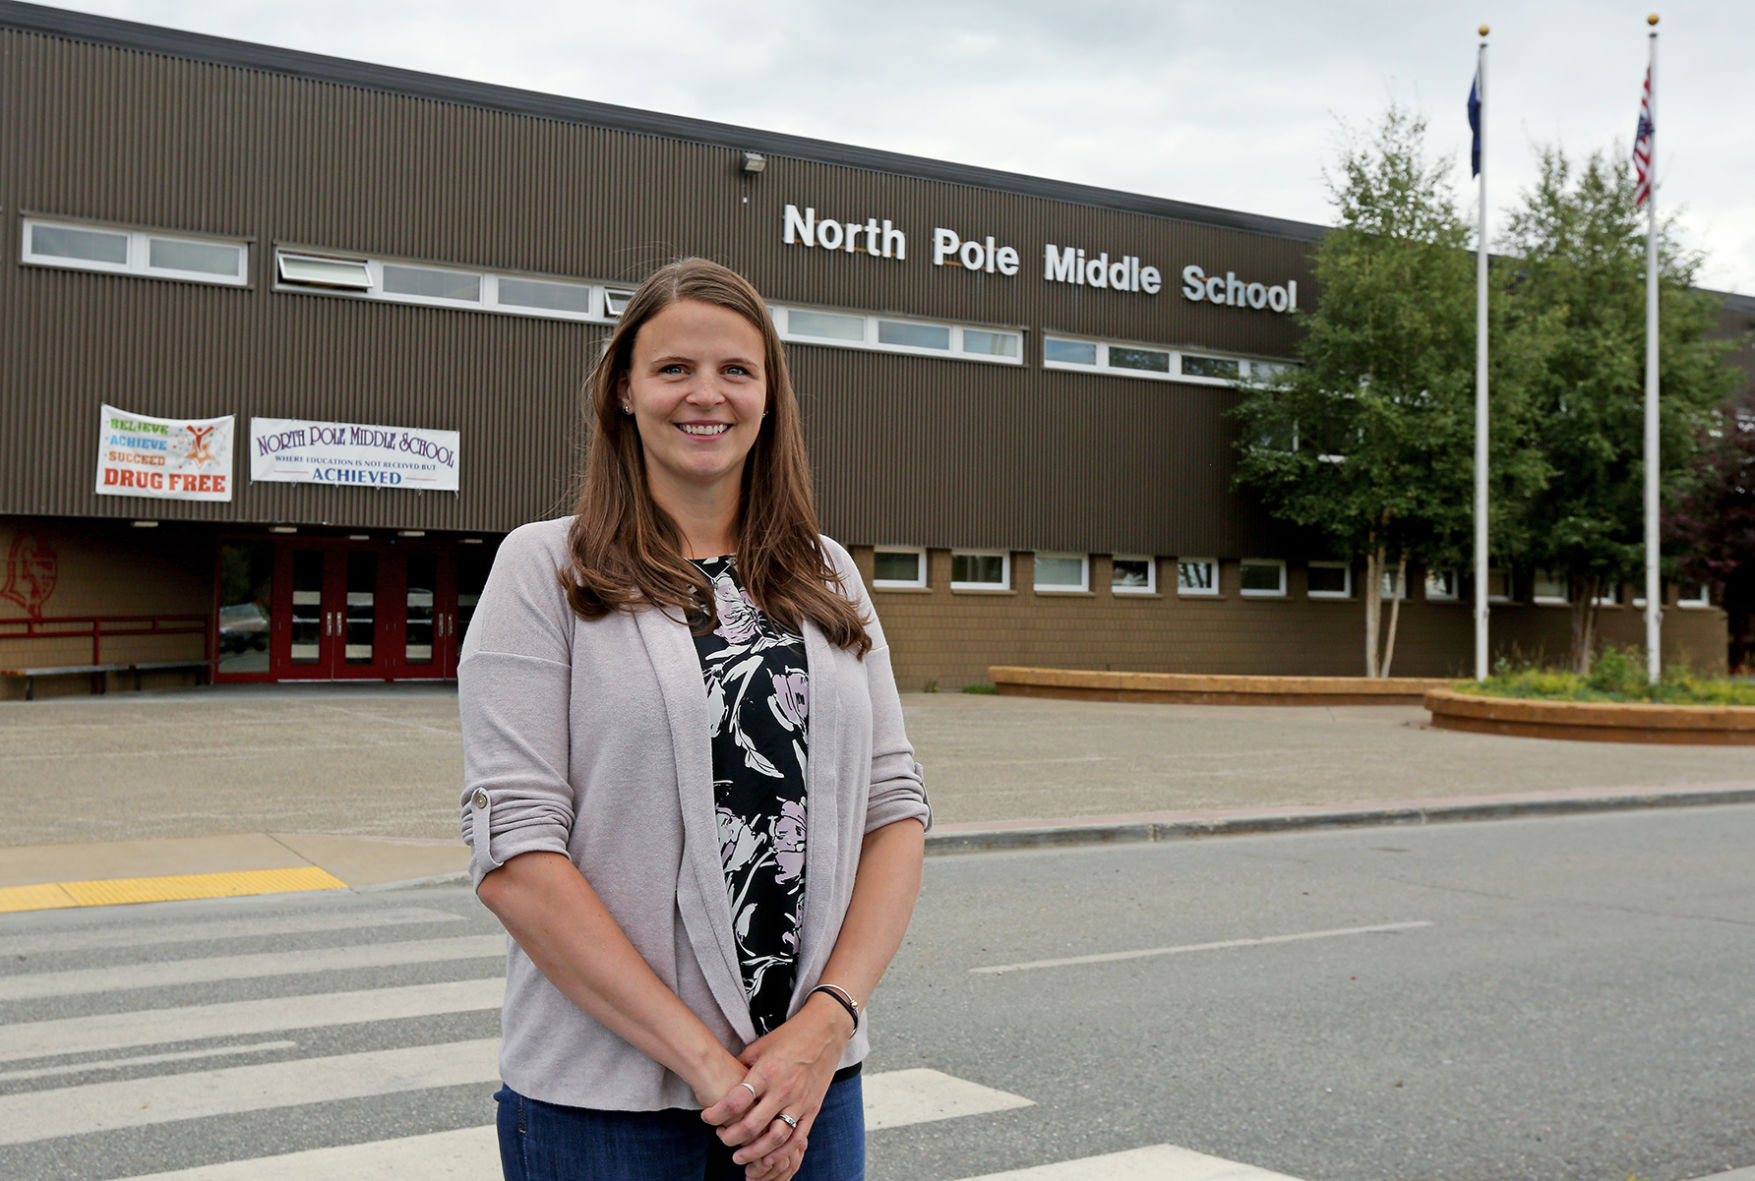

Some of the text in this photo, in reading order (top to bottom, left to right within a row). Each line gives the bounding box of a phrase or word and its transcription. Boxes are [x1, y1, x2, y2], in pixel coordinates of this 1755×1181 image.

[783, 204, 1298, 314] North Pole Middle School
[110, 418, 169, 435] BELIEVE
[110, 434, 168, 451] ACHIEVE
[257, 426, 455, 468] NORTH POLE MIDDLE SCHOOL
[108, 450, 166, 466] SUCCEED
[275, 455, 304, 463] WHERE
[306, 457, 353, 466] EDUCATION
[383, 462, 419, 470] RECEIVED
[104, 468, 226, 493] DRUG FREE
[312, 467, 402, 485] ACHIEVED
